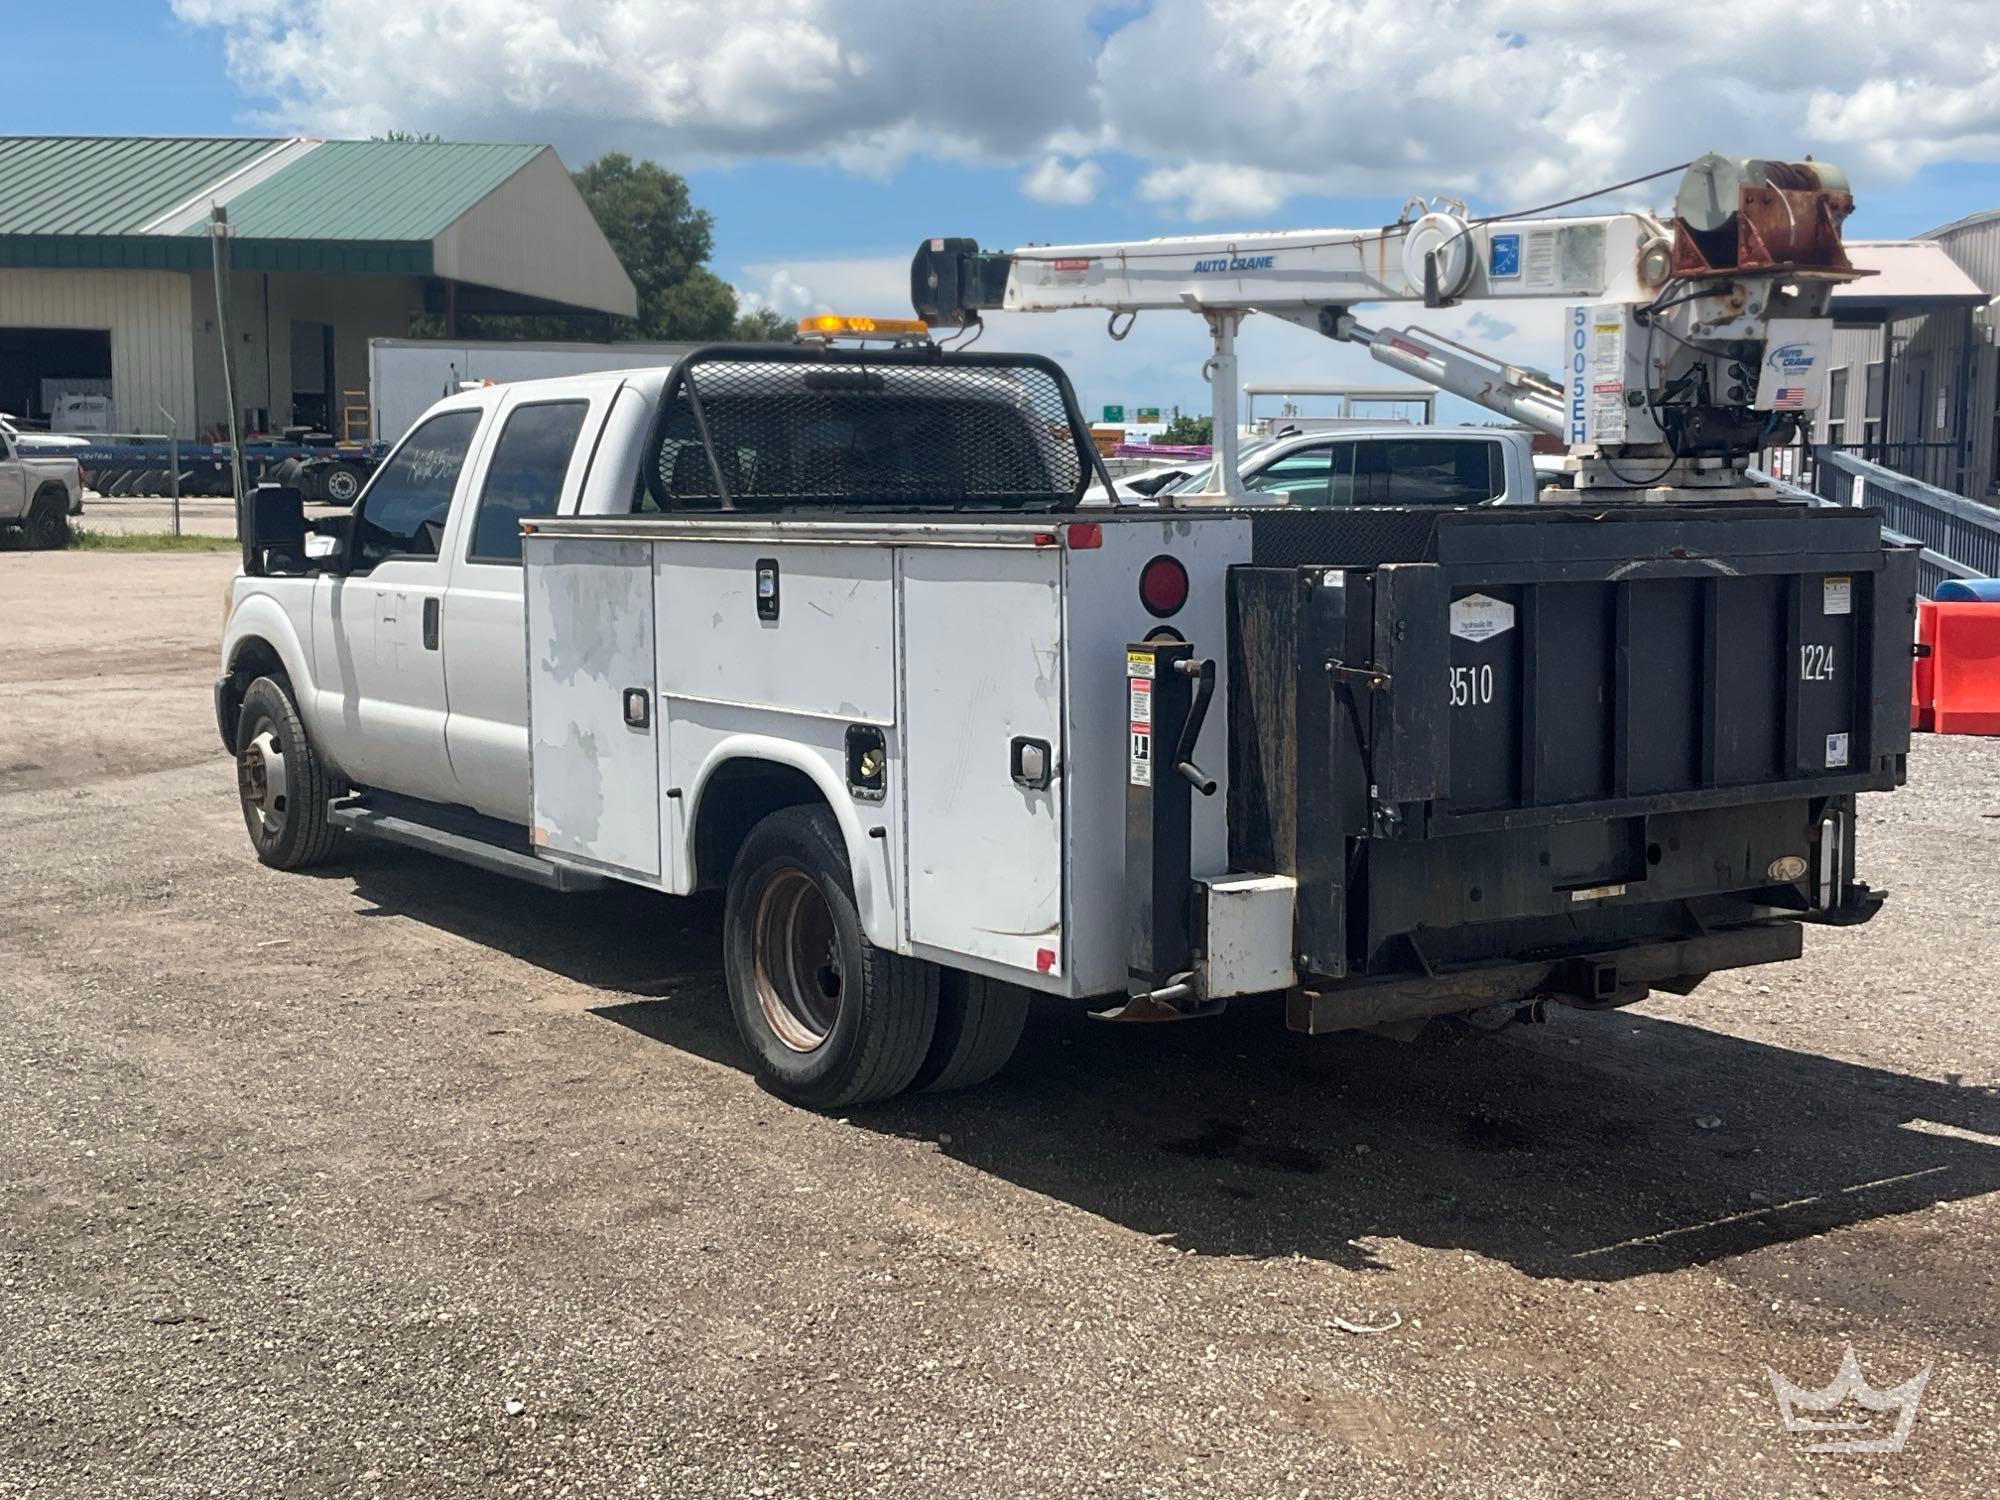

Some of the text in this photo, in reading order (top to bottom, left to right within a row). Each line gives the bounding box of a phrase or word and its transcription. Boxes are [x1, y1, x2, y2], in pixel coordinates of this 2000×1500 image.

[1194, 256, 1273, 273] AUTO CRANE
[1801, 645, 1834, 680] 1224
